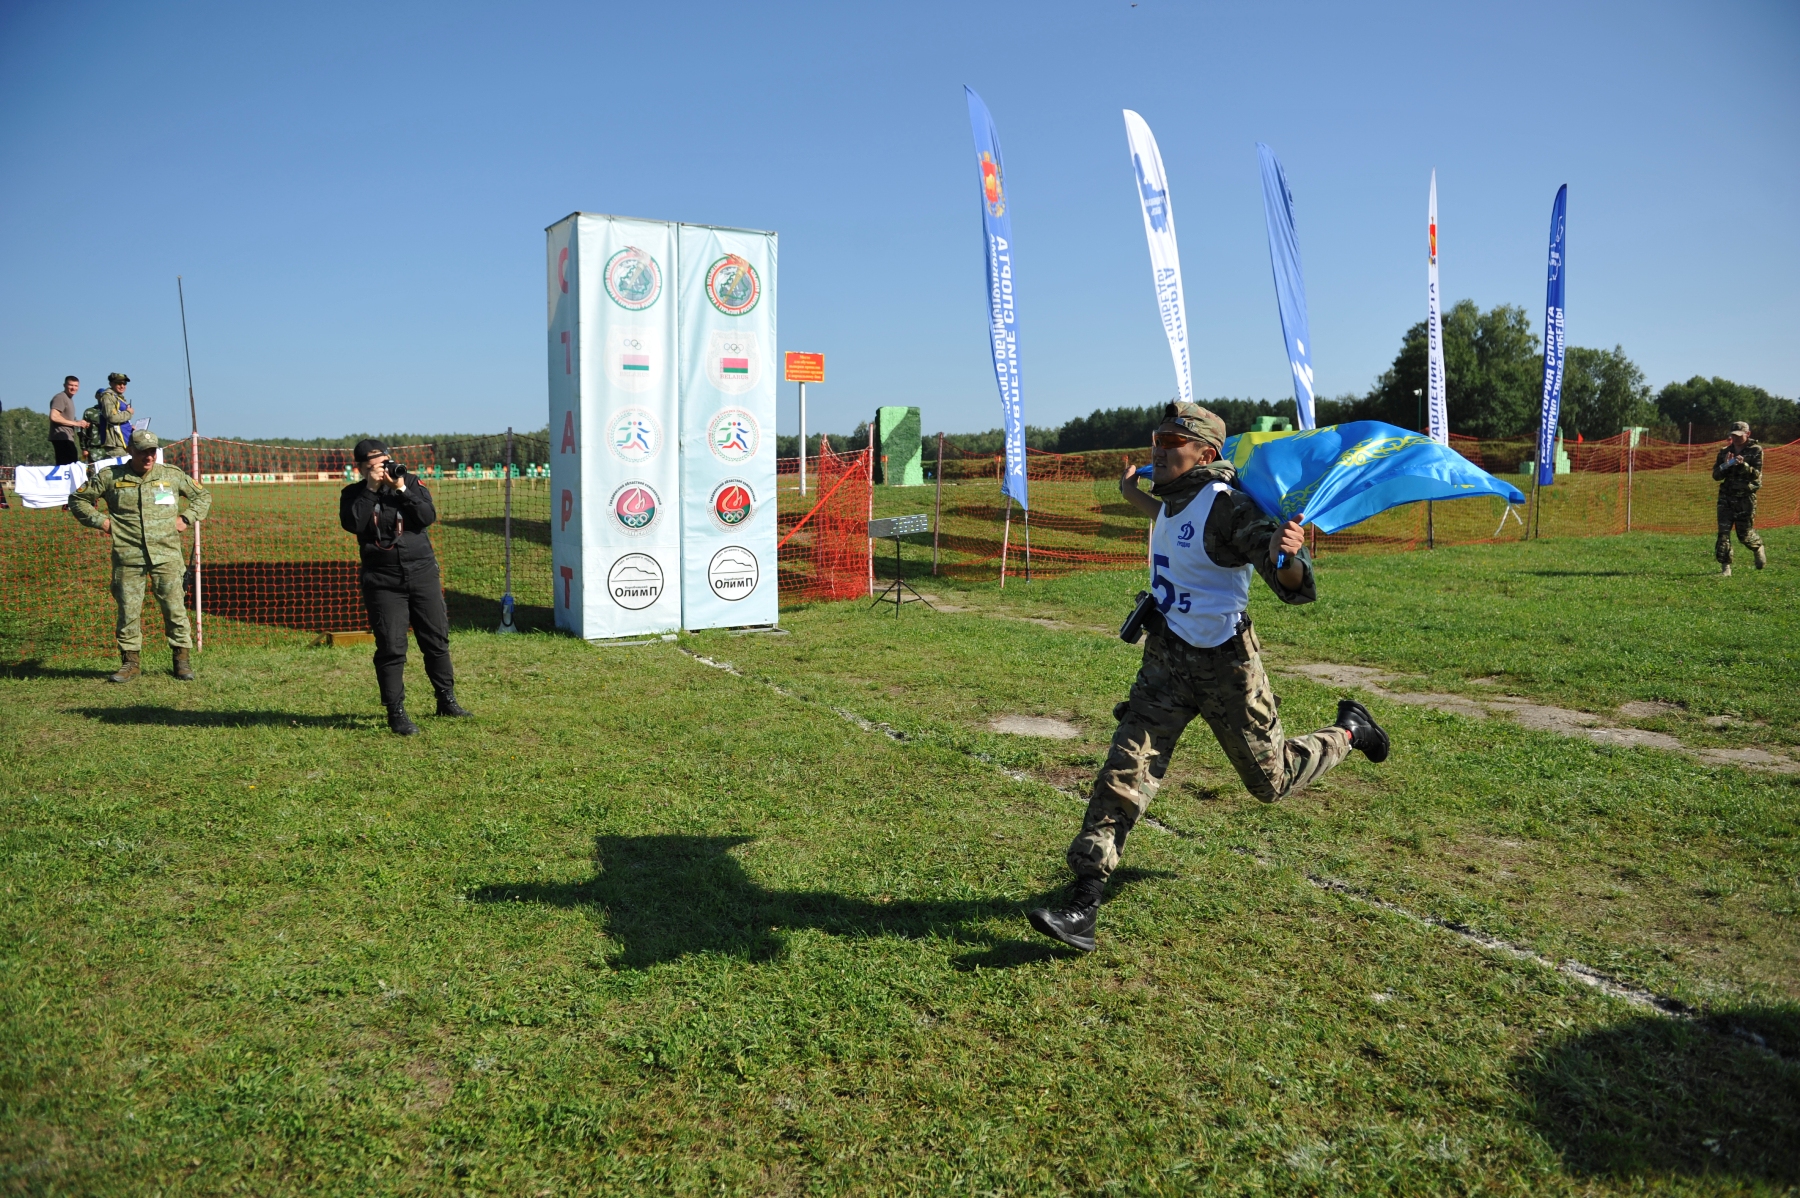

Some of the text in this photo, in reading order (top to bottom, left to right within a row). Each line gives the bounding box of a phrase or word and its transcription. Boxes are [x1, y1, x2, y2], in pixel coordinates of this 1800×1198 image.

[1547, 306, 1556, 367] СПОРТА
[1431, 355, 1440, 441] АВЛЕНИЕ
[64, 471, 71, 481] 5
[1152, 553, 1192, 614] 5 5
